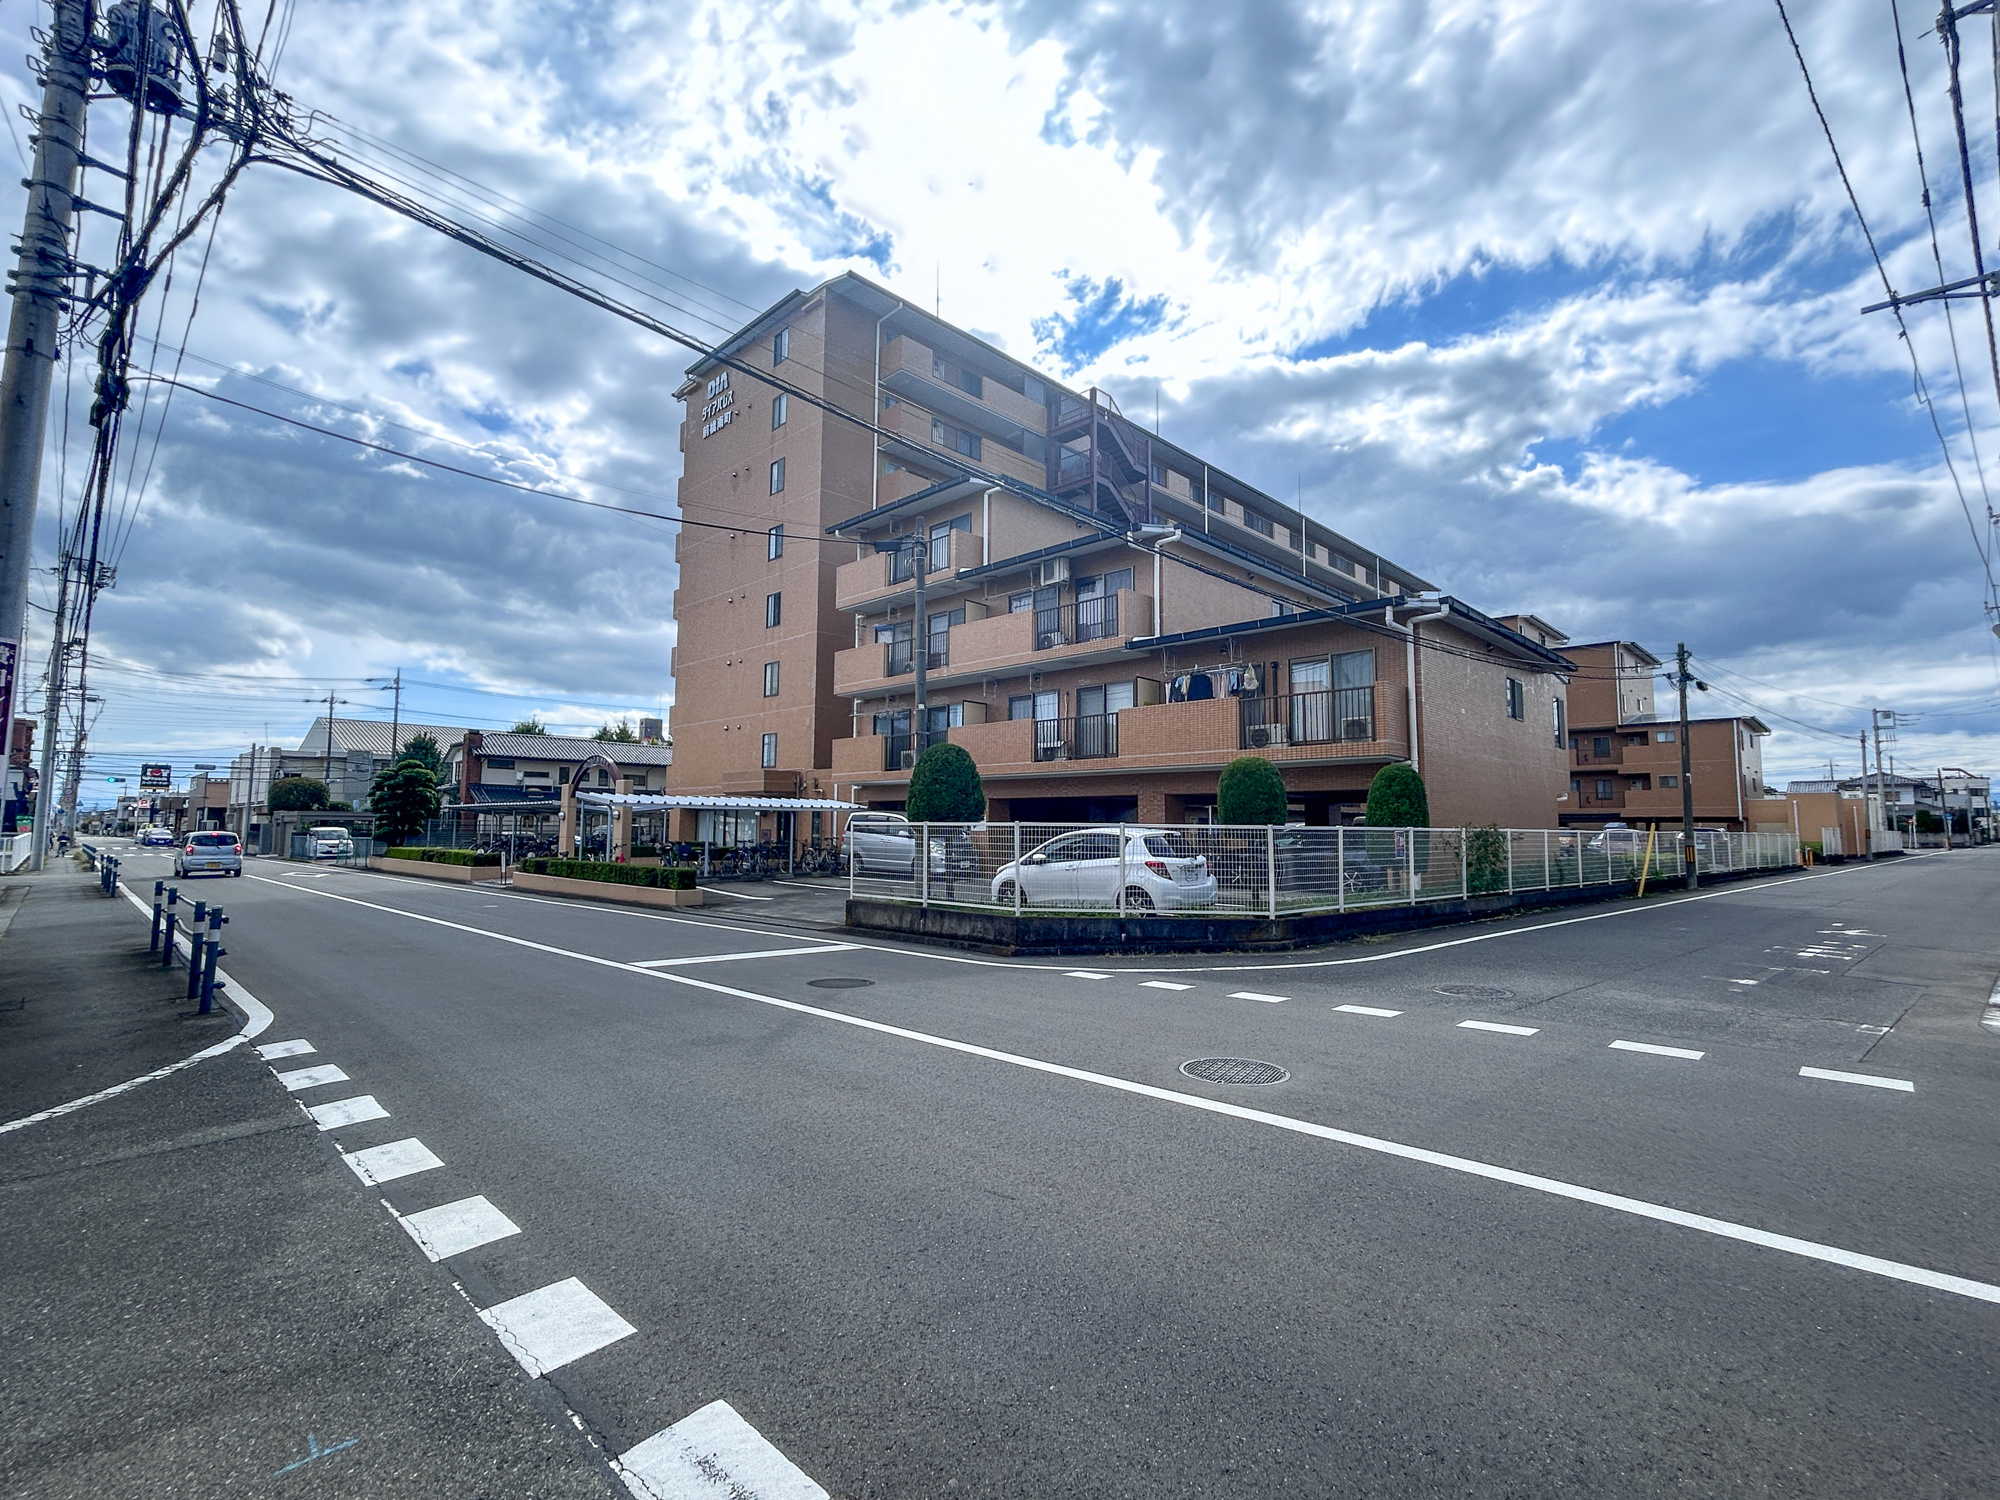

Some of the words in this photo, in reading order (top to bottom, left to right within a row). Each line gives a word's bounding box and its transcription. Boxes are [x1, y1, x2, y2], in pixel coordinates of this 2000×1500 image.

[702, 390, 734, 422] ダイアパレス
